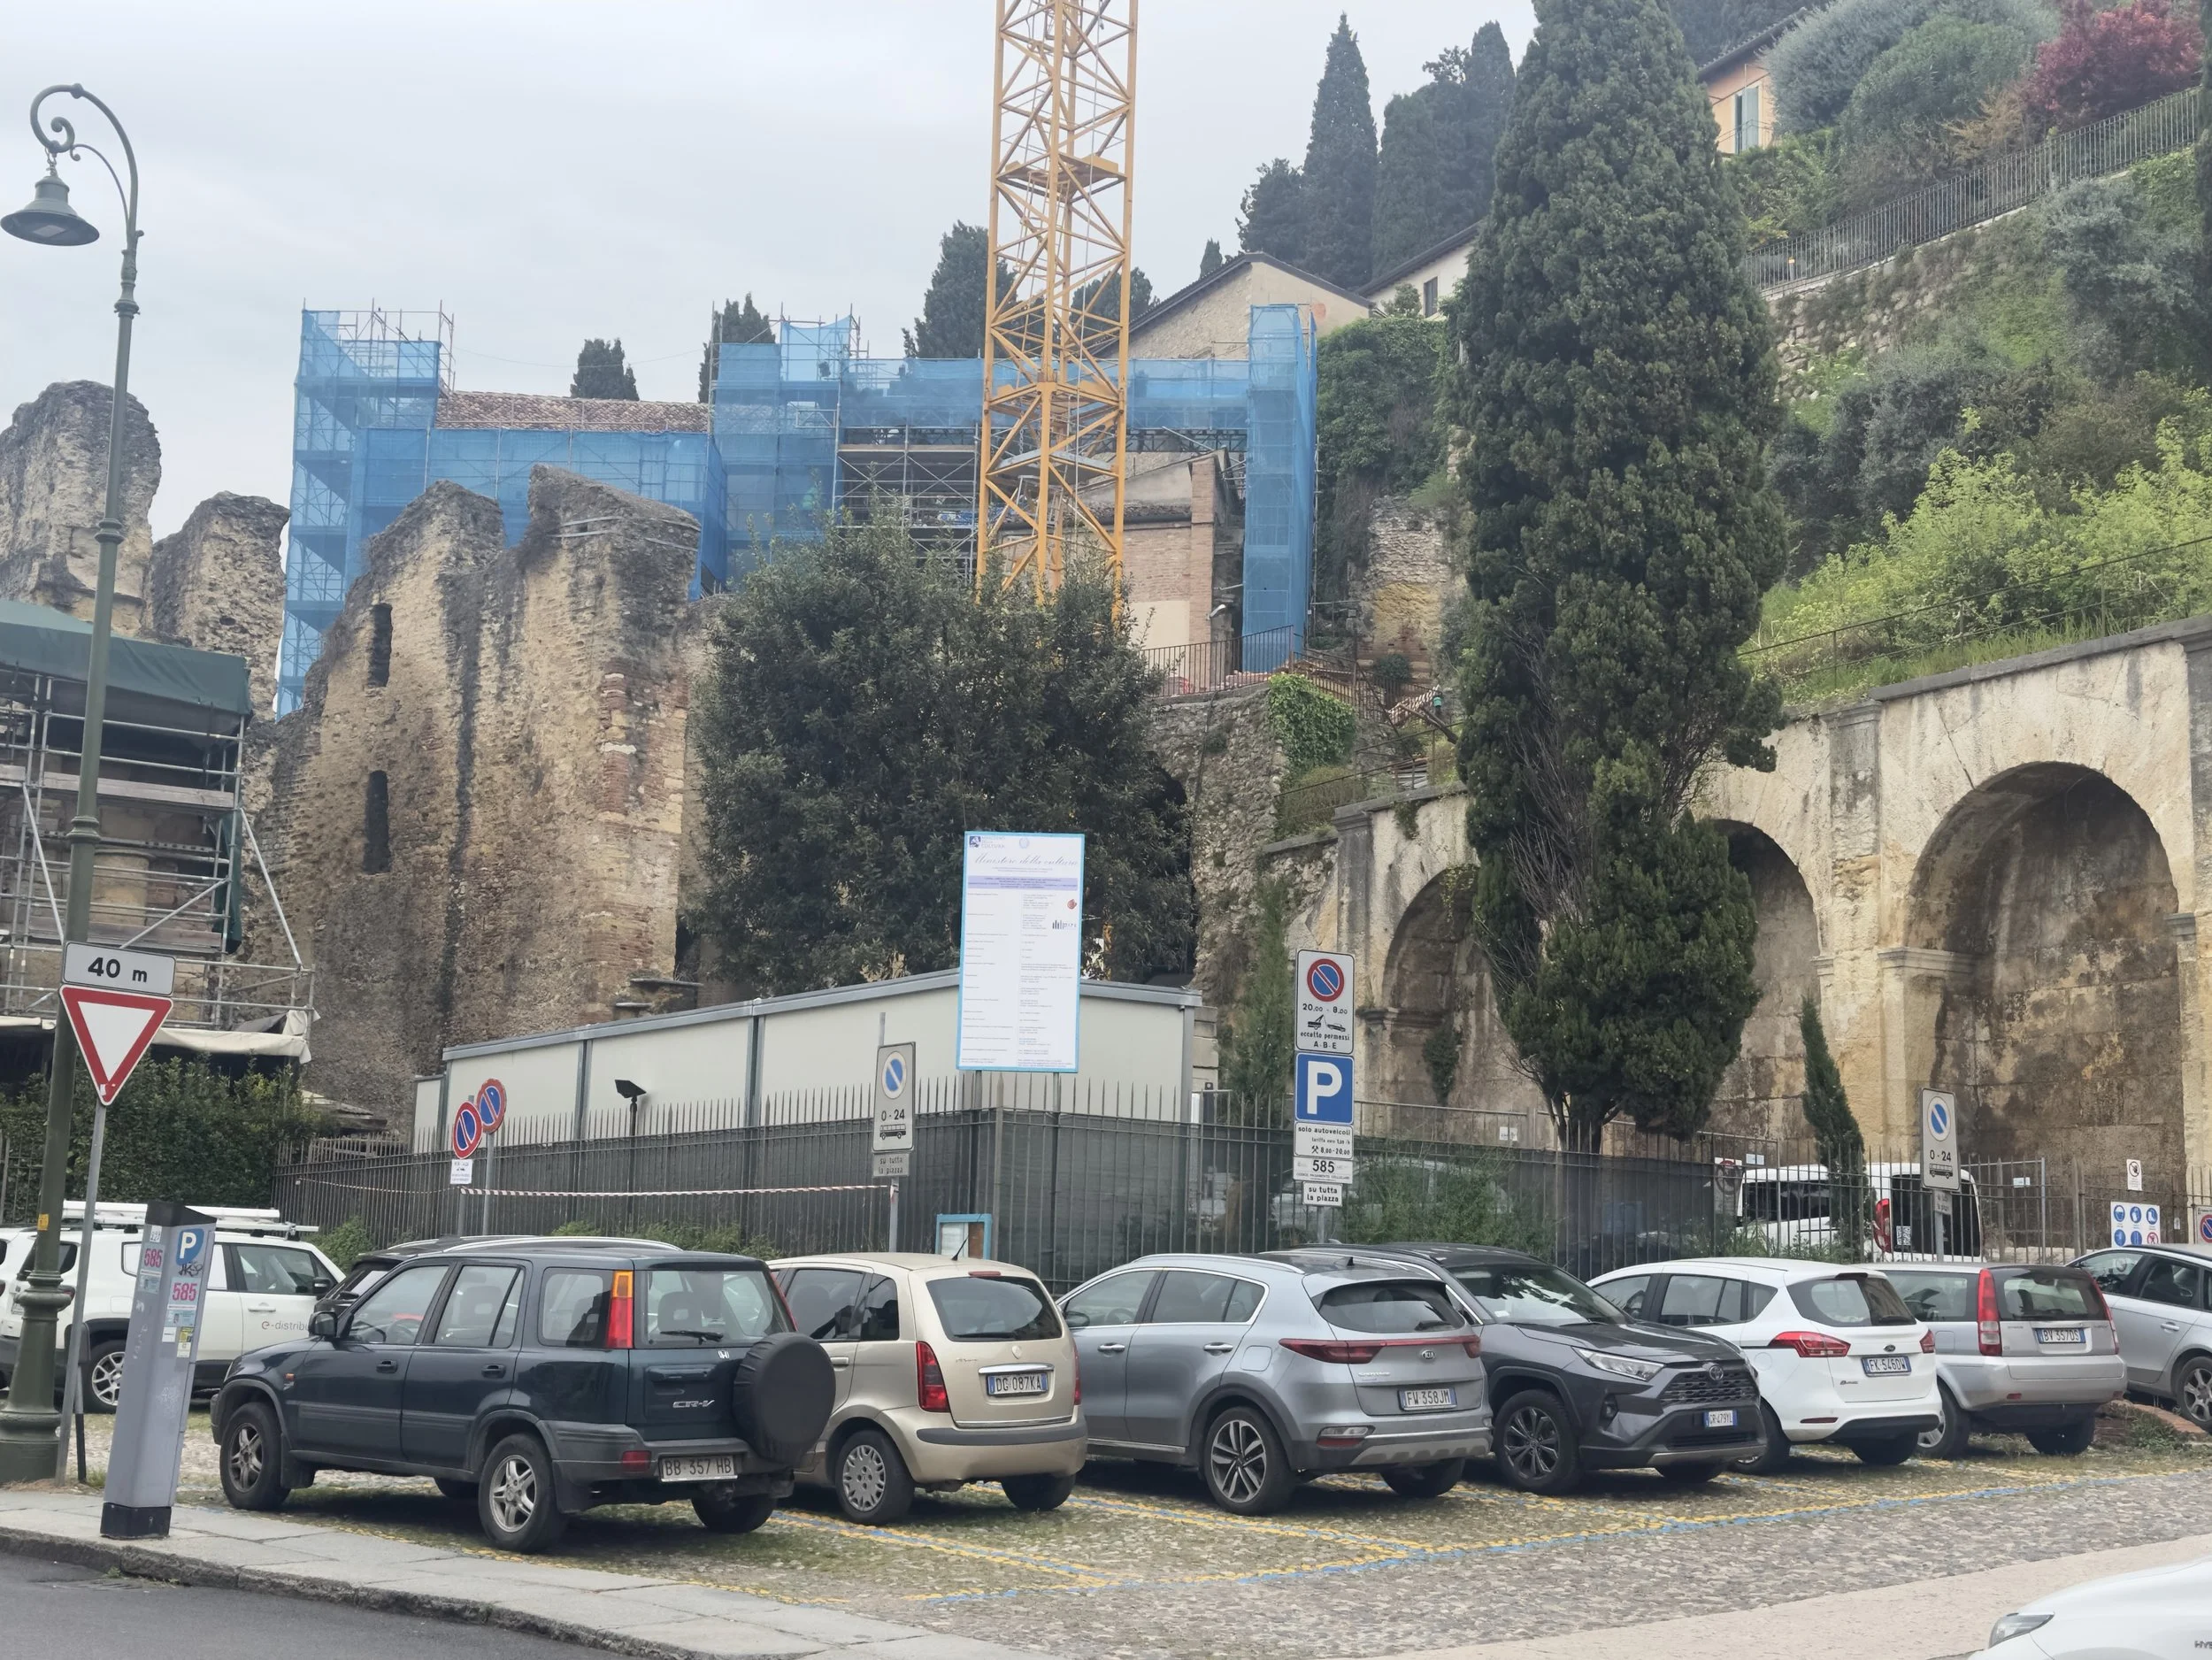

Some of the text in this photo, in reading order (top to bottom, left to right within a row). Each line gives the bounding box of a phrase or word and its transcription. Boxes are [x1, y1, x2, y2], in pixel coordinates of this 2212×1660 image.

[88, 957, 148, 982] 40 m
[1307, 1061, 1342, 1115] P
[881, 1110, 887, 1121] 0
[894, 1109, 905, 1120] 24
[1930, 1149, 1935, 1161] 0
[1941, 1151, 1951, 1162] 24
[1312, 1160, 1334, 1172] 585
[180, 1232, 196, 1258] P
[144, 1249, 163, 1267] 585
[173, 1283, 197, 1302] 585
[665, 1458, 732, 1476] BB 357 HB
